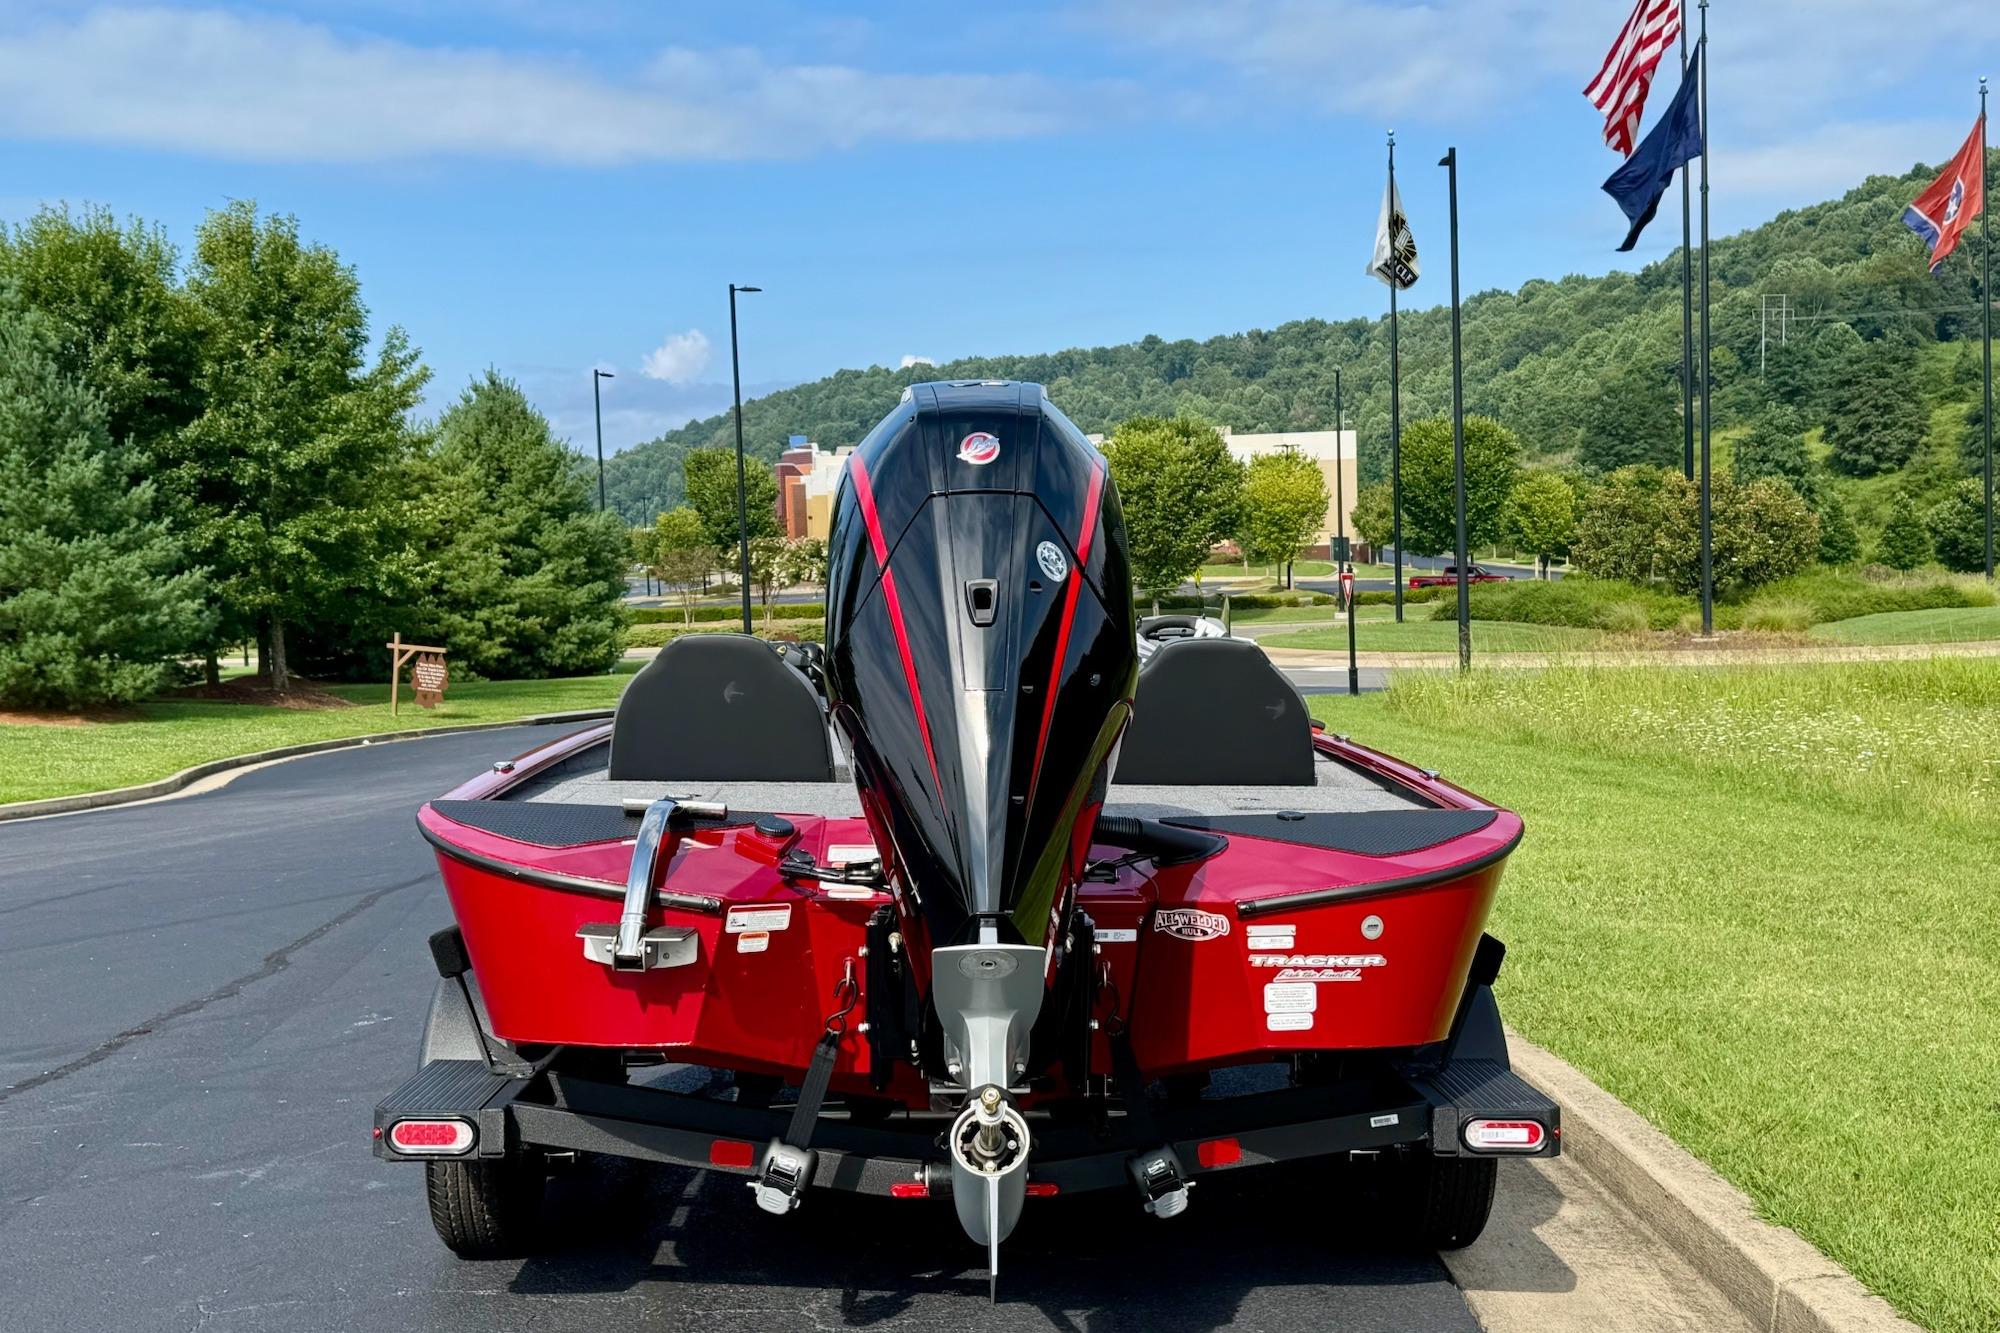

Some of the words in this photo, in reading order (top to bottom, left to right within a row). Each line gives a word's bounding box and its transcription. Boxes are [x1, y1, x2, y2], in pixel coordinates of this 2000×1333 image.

[1156, 911, 1178, 928] ALL
[1178, 912, 1227, 932] WELDED
[1182, 927, 1203, 936] HULL
[1251, 956, 1382, 966] TRACKER
[1278, 970, 1300, 978] Fish
